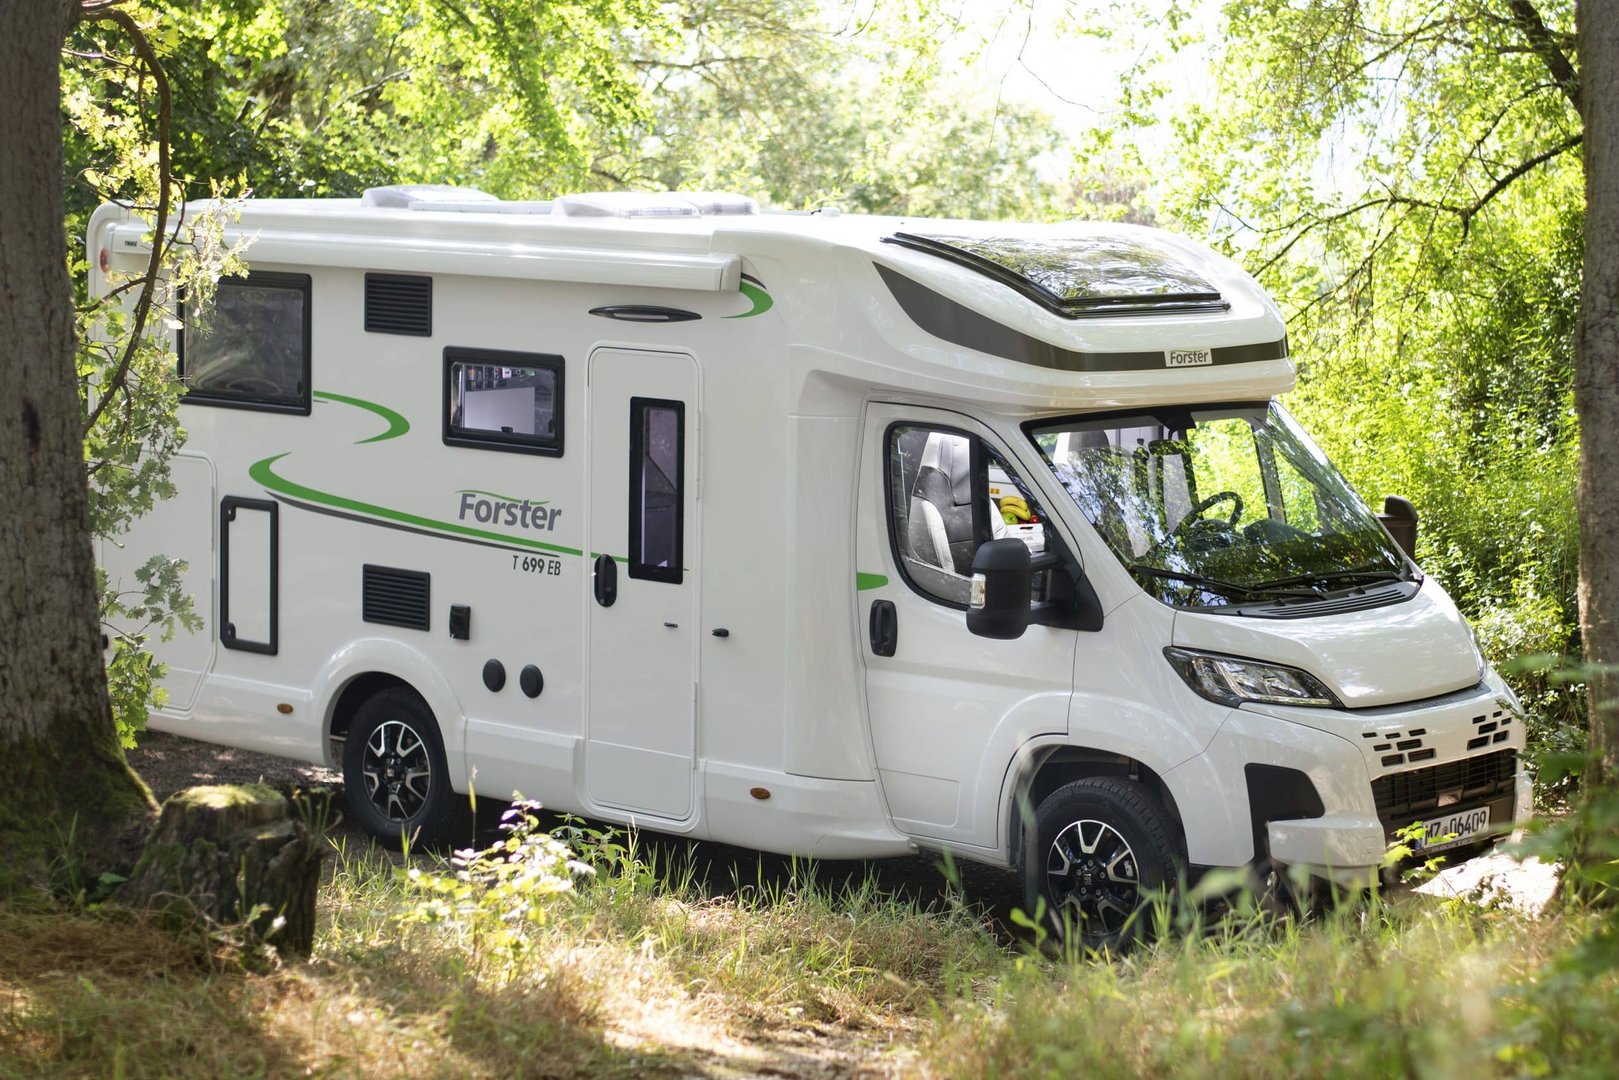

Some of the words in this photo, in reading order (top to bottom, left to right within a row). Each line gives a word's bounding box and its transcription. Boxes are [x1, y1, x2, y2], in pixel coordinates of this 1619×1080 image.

[1170, 350, 1209, 365] Forster
[459, 492, 562, 532] Forster
[512, 555, 519, 570] T
[522, 556, 545, 574] 699
[547, 560, 561, 576] EB
[1449, 810, 1487, 838] 06409
